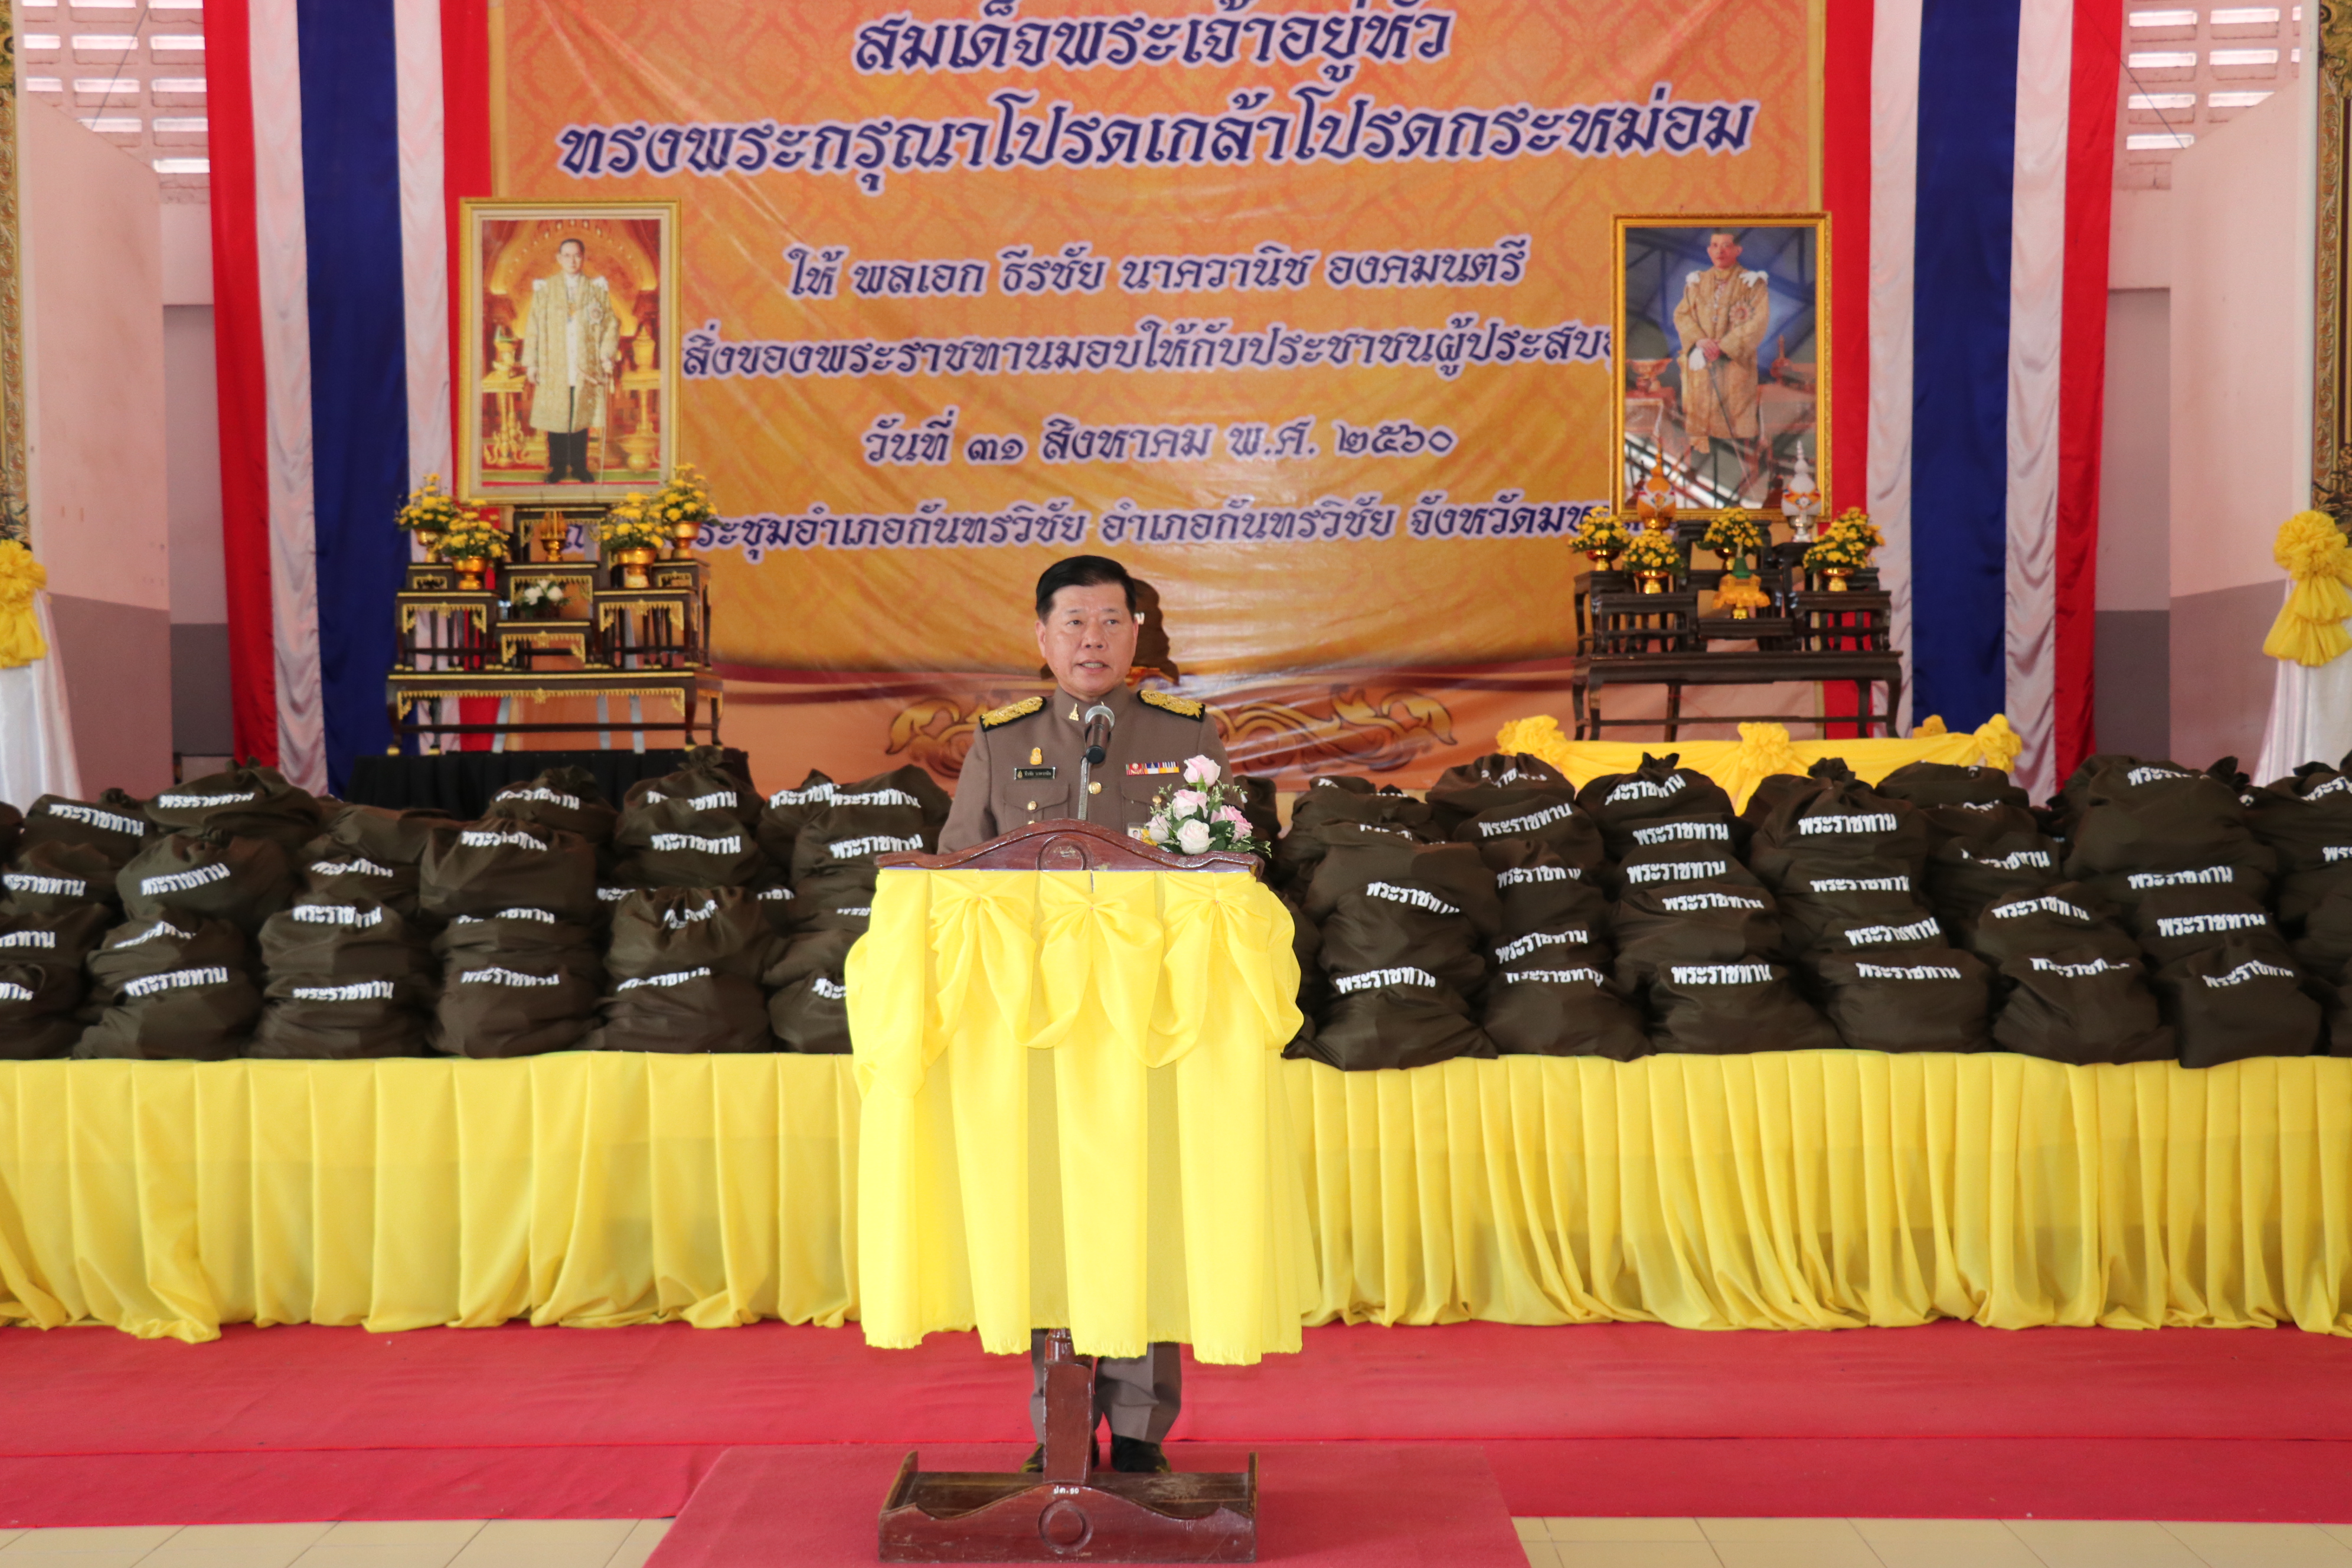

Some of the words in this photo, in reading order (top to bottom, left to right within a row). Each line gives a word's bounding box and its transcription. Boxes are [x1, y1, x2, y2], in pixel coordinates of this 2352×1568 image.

[561, 87, 1754, 191] ทรงพระกรุณาโปรดเกล้าโปรดกระหม่อม
[788, 249, 844, 295] ให้
[854, 263, 985, 294] พลเอก
[1002, 247, 1105, 292] ธีรชัย
[1123, 246, 1315, 289] นาควานิช
[1329, 240, 1526, 284] องคมนตรี
[867, 410, 953, 462] วันที่
[968, 438, 1023, 460] ๓๑
[1044, 419, 1210, 460] สิงหาคม
[1231, 422, 1315, 456] พ.ศ.
[1340, 424, 1453, 454] ๒๕๖๐
[1103, 497, 1394, 541] อำเภอกันทรวิชัย
[49, 799, 143, 836] พระราชทาน
[1479, 803, 1572, 837] พระราชทาน
[1798, 814, 1896, 835] พระราชทาน
[651, 834, 741, 854] พระราชทาน
[1633, 822, 1729, 845] พระราชทาน
[829, 834, 923, 858] พระราชทาน
[141, 863, 230, 896] พระราชทาน
[1626, 861, 1726, 883] พระราชทาน
[2128, 866, 2232, 889] พระราชทาน
[1662, 893, 1764, 910] พระราชทาน
[1844, 917, 1940, 946] พระราชทาน
[2157, 914, 2265, 936] พระราชทาน
[1495, 930, 1587, 963] พระราชทาน
[123, 967, 228, 997] พระราชทาน
[460, 967, 559, 986] พระราชทาน
[1335, 966, 1435, 994] พระราชทาน
[1671, 965, 1772, 984] พระราชทาน
[1856, 963, 1961, 979] พระราชทาน
[293, 981, 394, 1001] พระราชทาน
